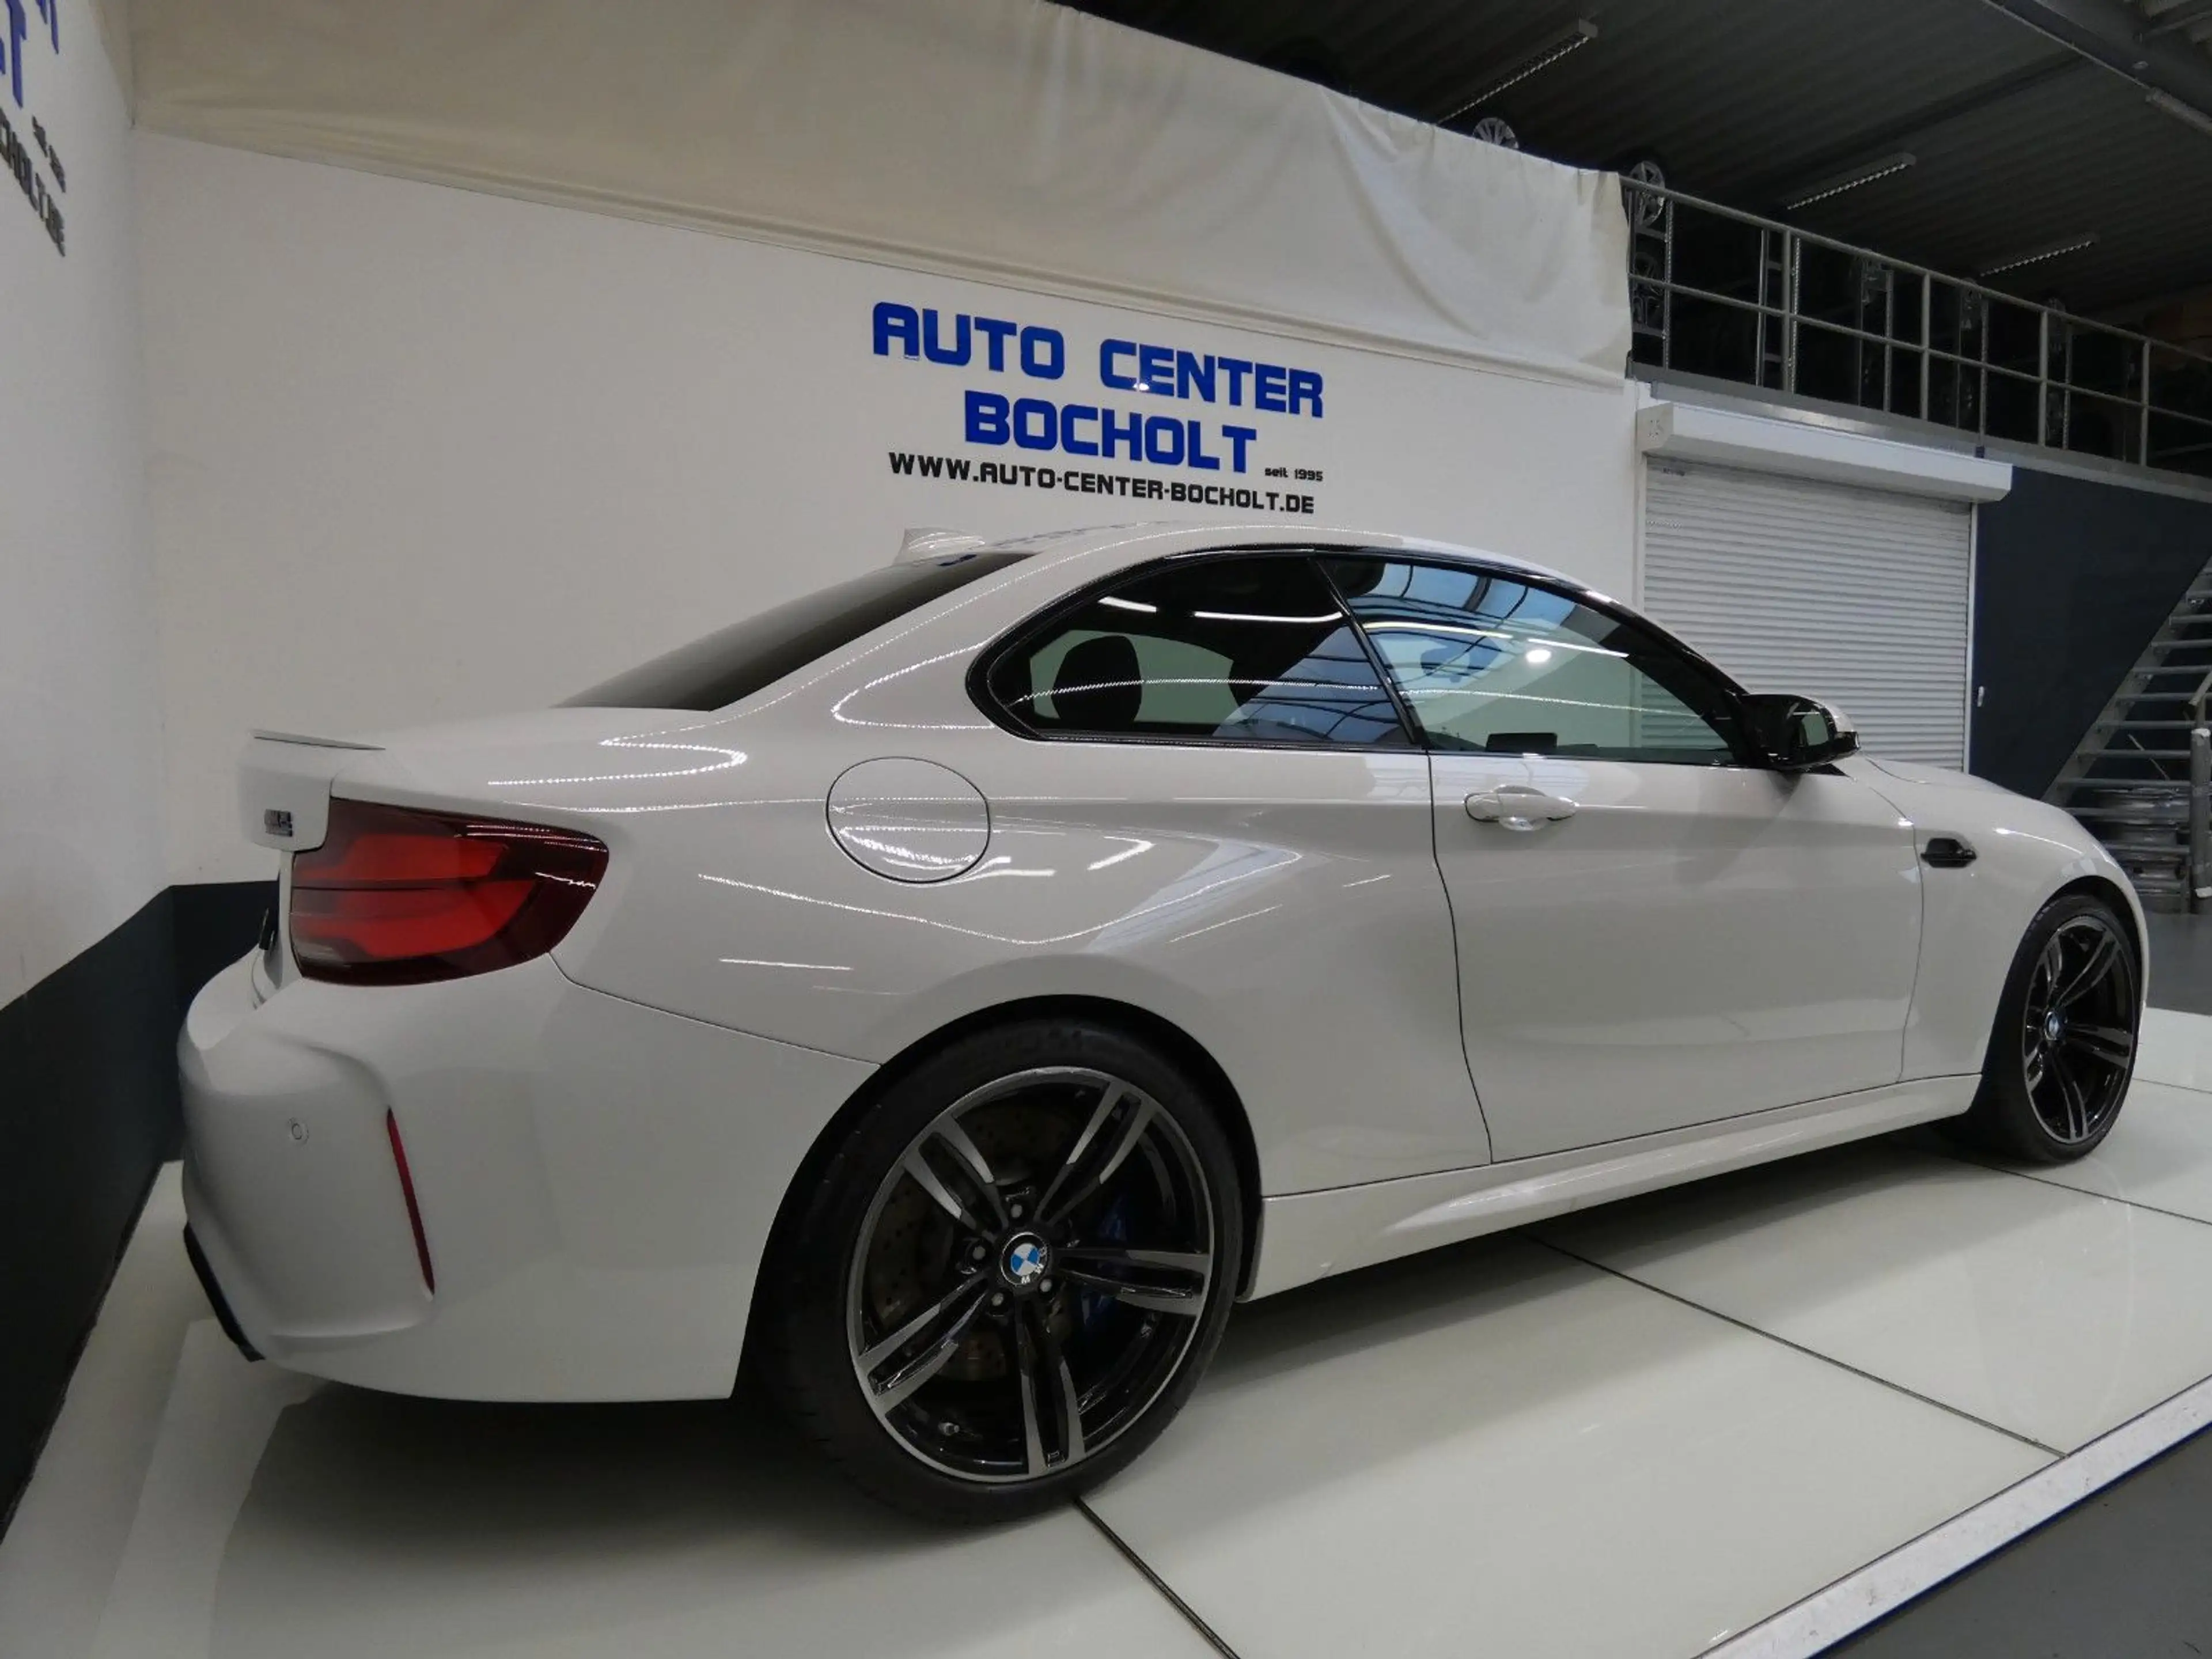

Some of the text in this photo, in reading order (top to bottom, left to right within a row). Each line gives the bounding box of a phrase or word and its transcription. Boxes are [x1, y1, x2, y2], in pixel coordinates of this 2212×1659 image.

[873, 302, 1324, 419] AUTO CENTER
[964, 390, 1257, 474] BOCHOLT
[888, 452, 1315, 514] WWW.AUTO-CENTER-BOCHOLT.DE
[1264, 467, 1324, 482] seit 1995
